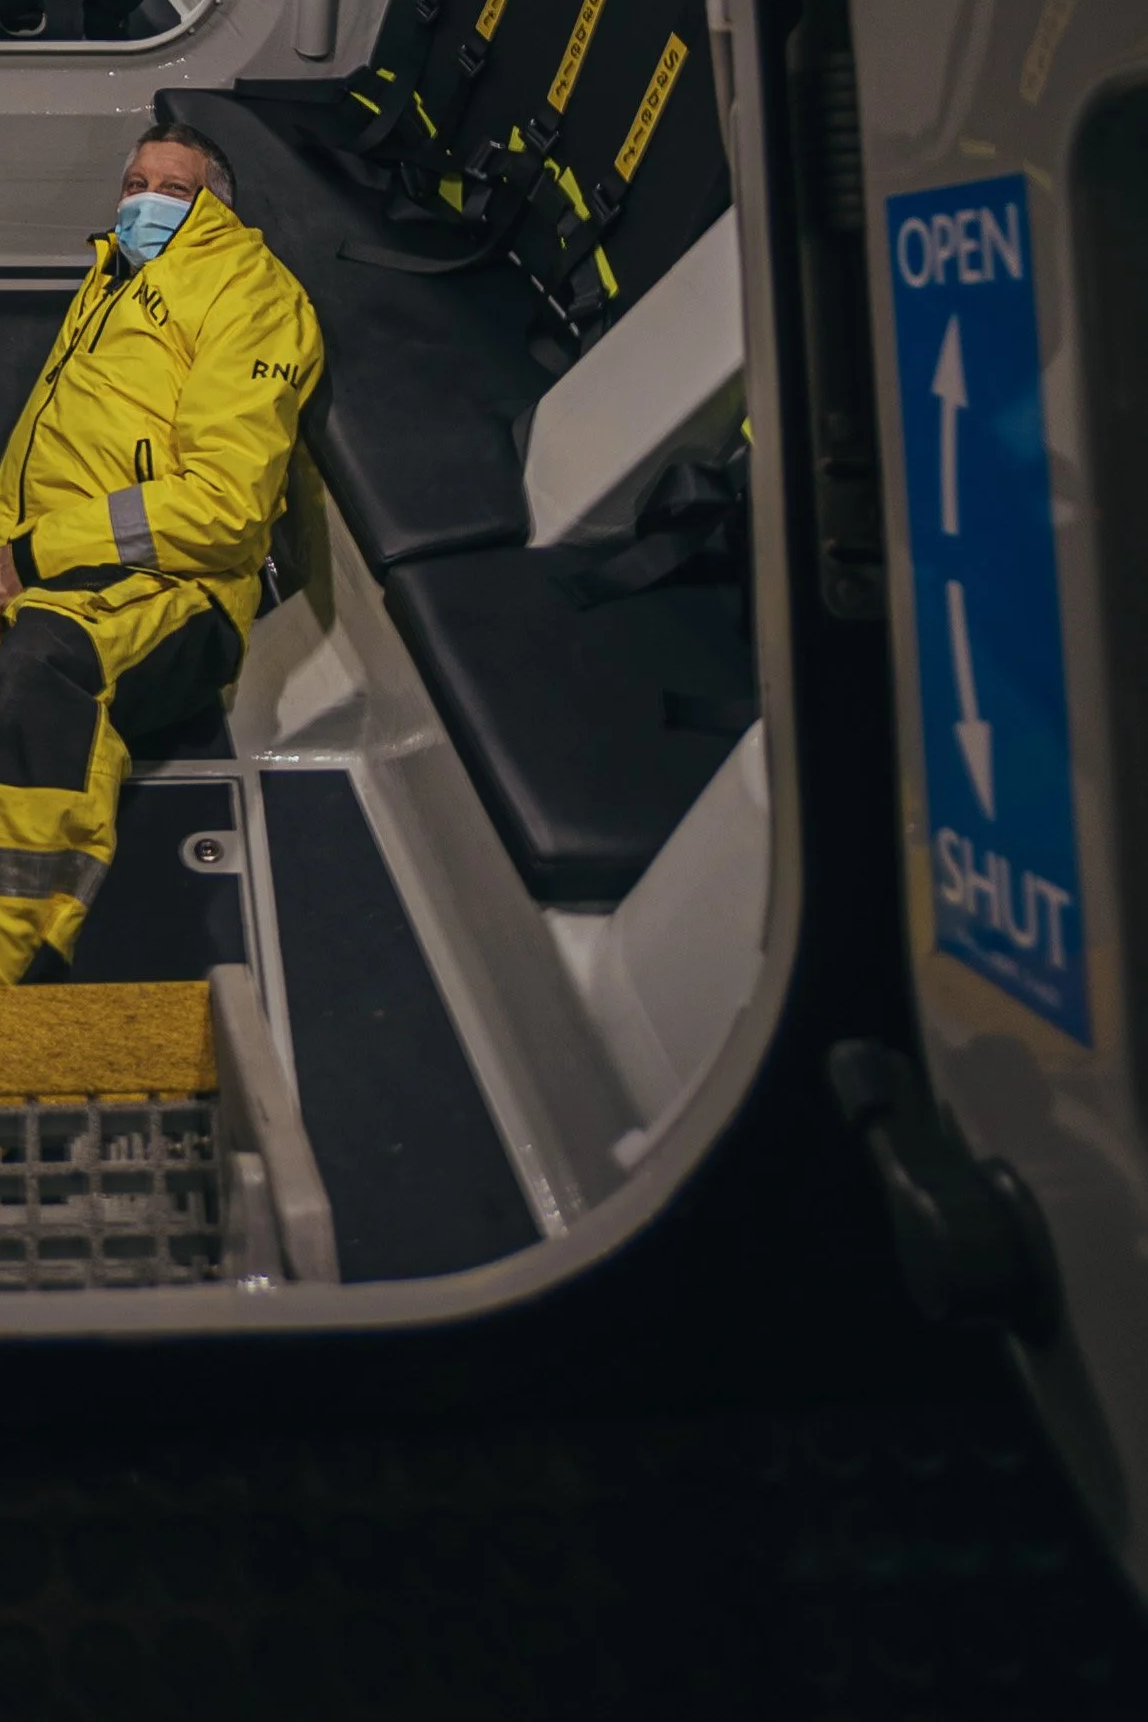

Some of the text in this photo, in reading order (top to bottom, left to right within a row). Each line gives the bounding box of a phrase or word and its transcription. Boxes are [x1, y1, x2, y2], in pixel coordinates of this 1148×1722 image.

[623, 48, 679, 163] Sabelt
[896, 201, 1024, 289] OPEN
[937, 825, 1072, 971] SHUT
